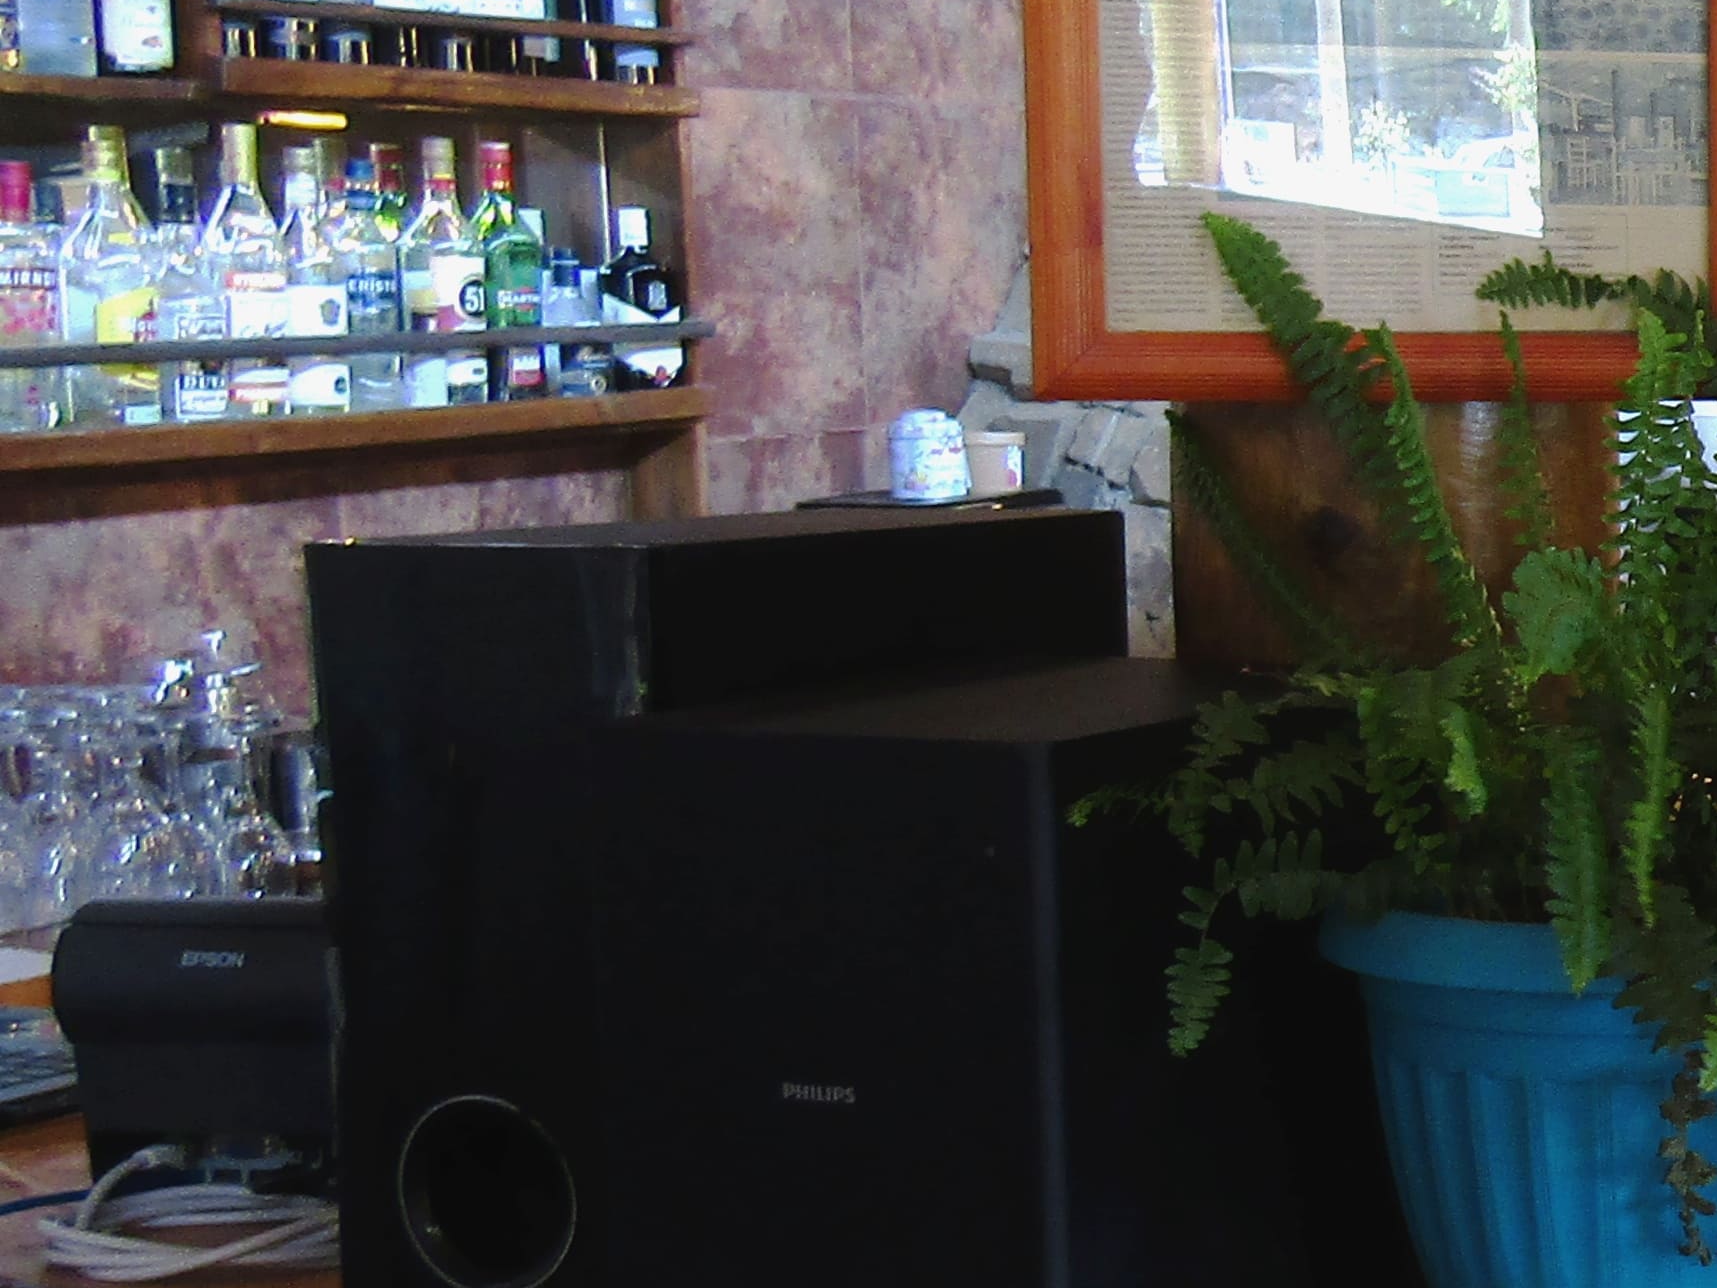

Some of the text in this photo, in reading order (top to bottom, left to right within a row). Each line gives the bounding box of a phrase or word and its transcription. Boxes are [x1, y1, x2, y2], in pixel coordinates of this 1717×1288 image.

[464, 288, 485, 311] 51
[181, 951, 245, 968] EPSON
[783, 1082, 857, 1104] PHILIPS
